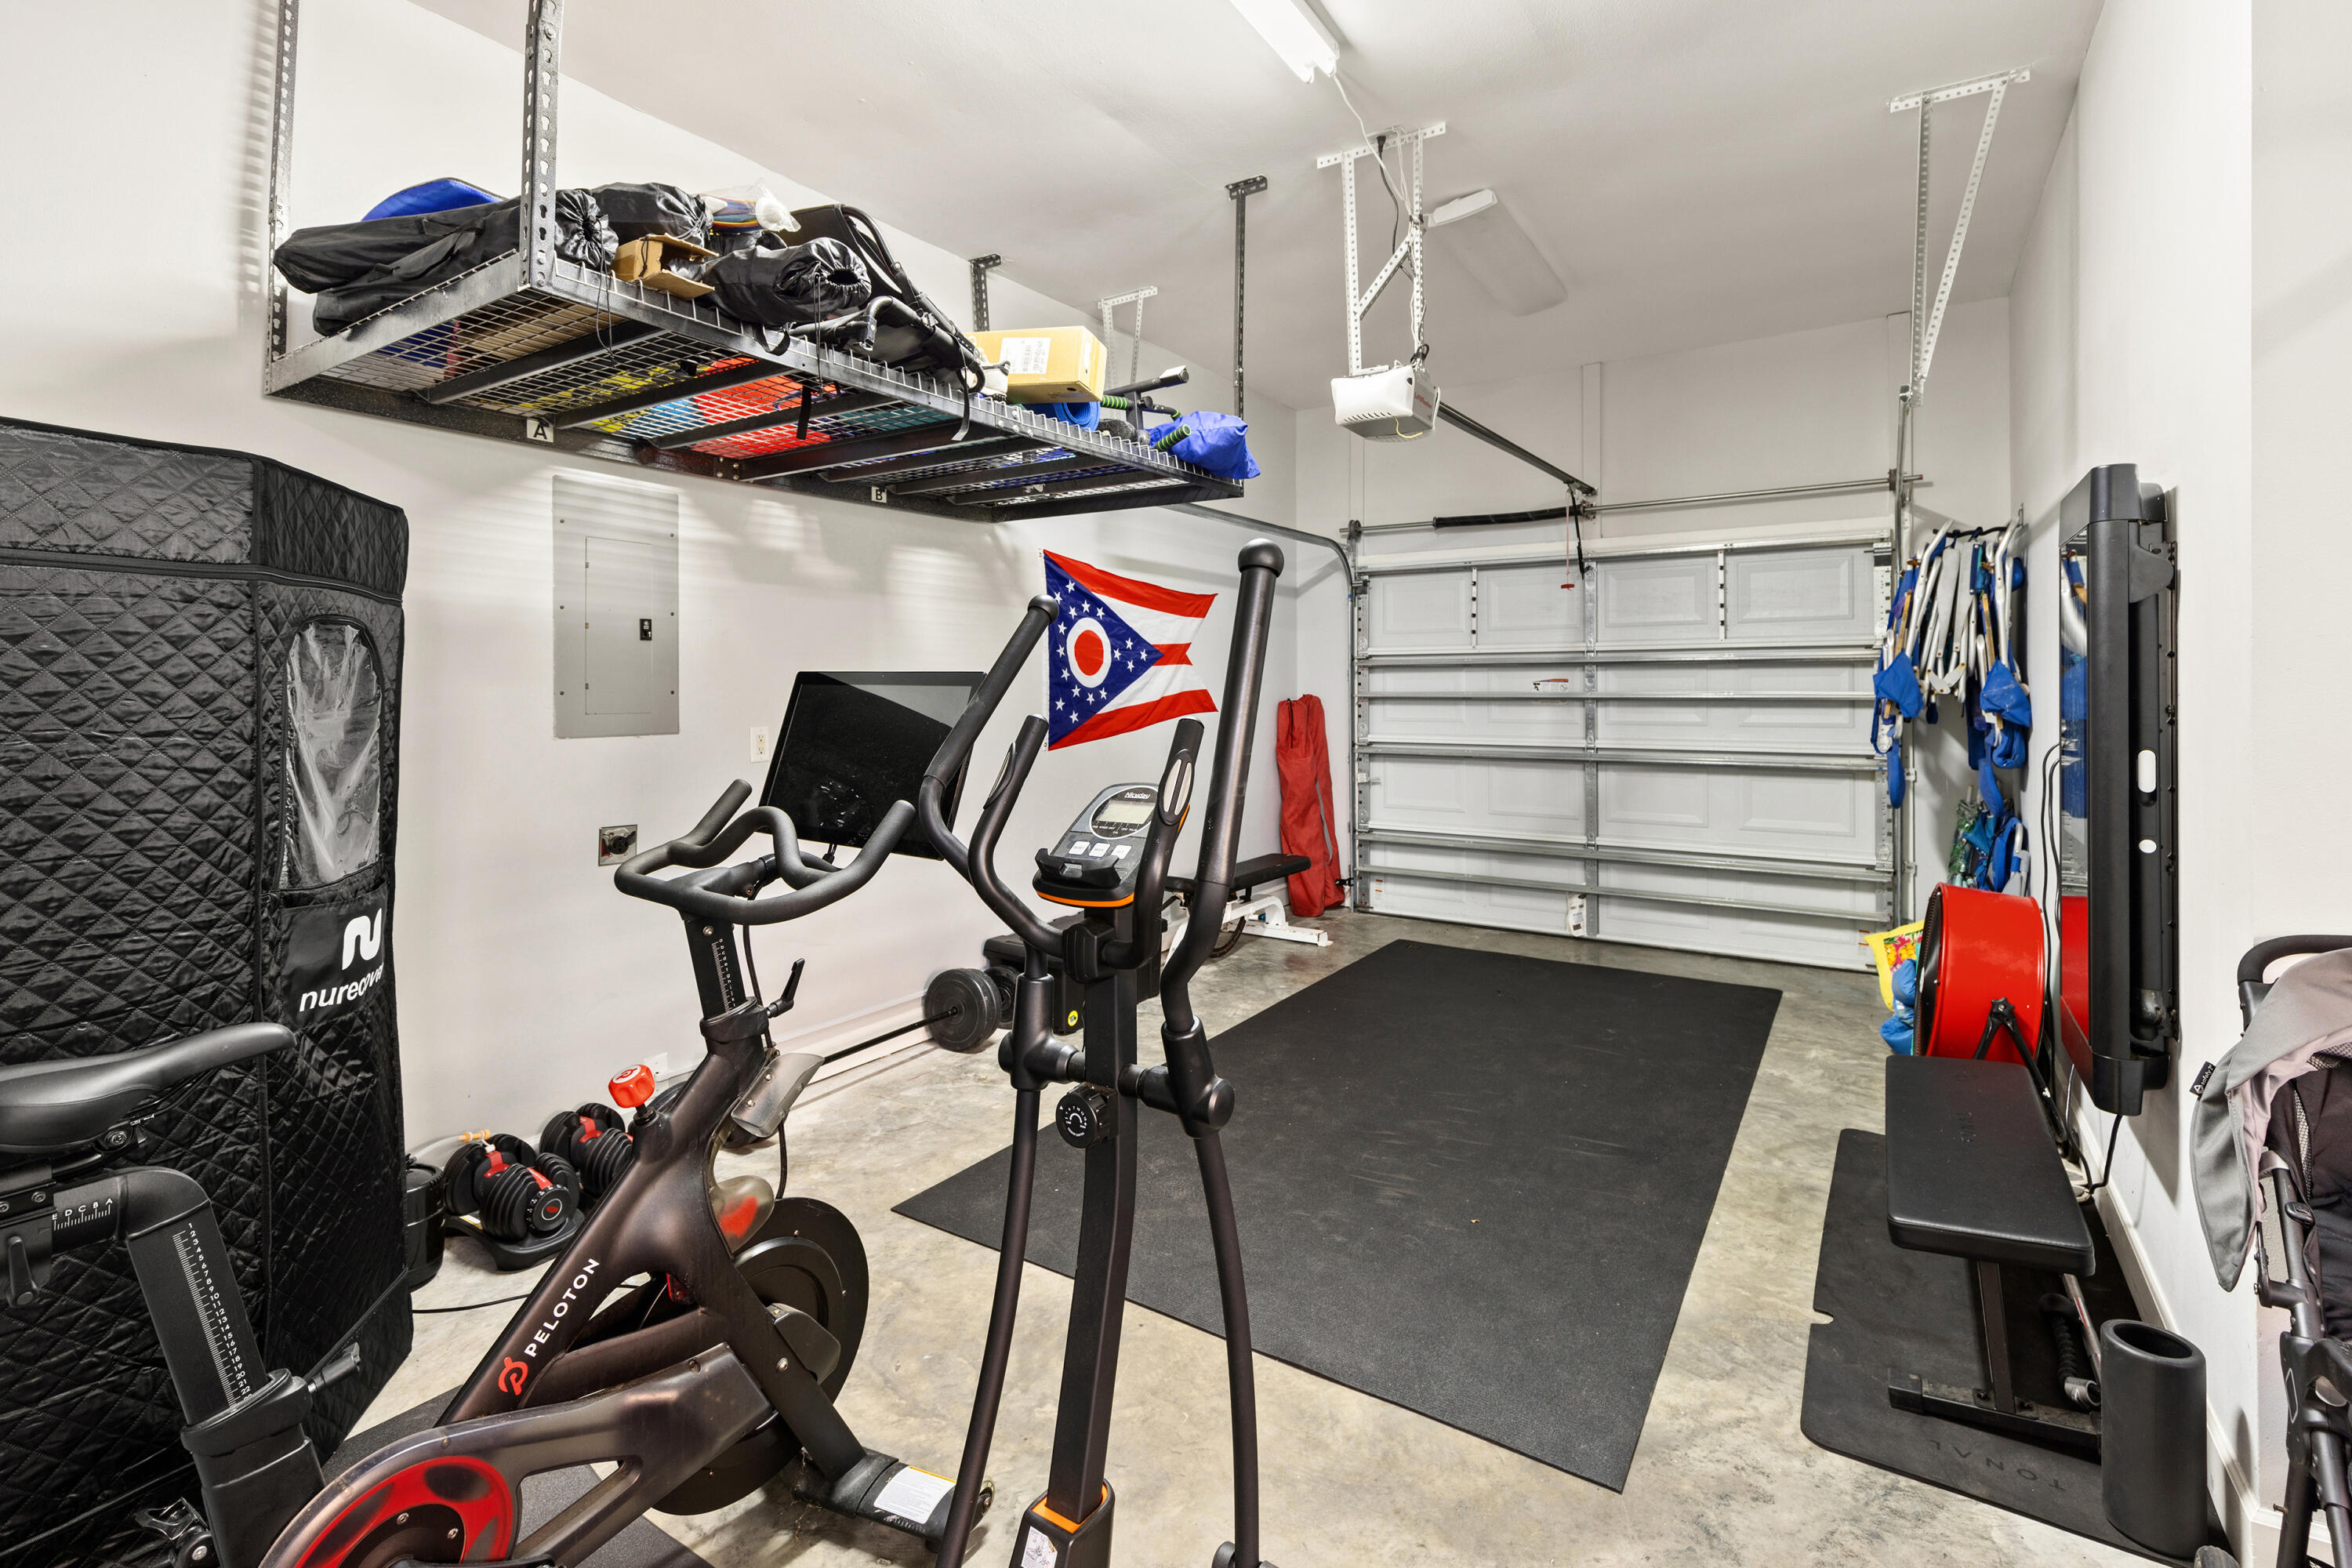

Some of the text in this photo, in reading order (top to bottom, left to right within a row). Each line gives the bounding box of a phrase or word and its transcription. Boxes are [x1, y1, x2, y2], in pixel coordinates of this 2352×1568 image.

[533, 422, 547, 440] A
[875, 488, 883, 500] B
[524, 1258, 600, 1358] PELOTON
[223, 1332, 233, 1341] 15
[226, 1340, 235, 1348] 16
[236, 1371, 245, 1380] 20
[238, 1379, 246, 1388] 21
[241, 1386, 251, 1395] 22
[1929, 1439, 2066, 1490] TONAL
